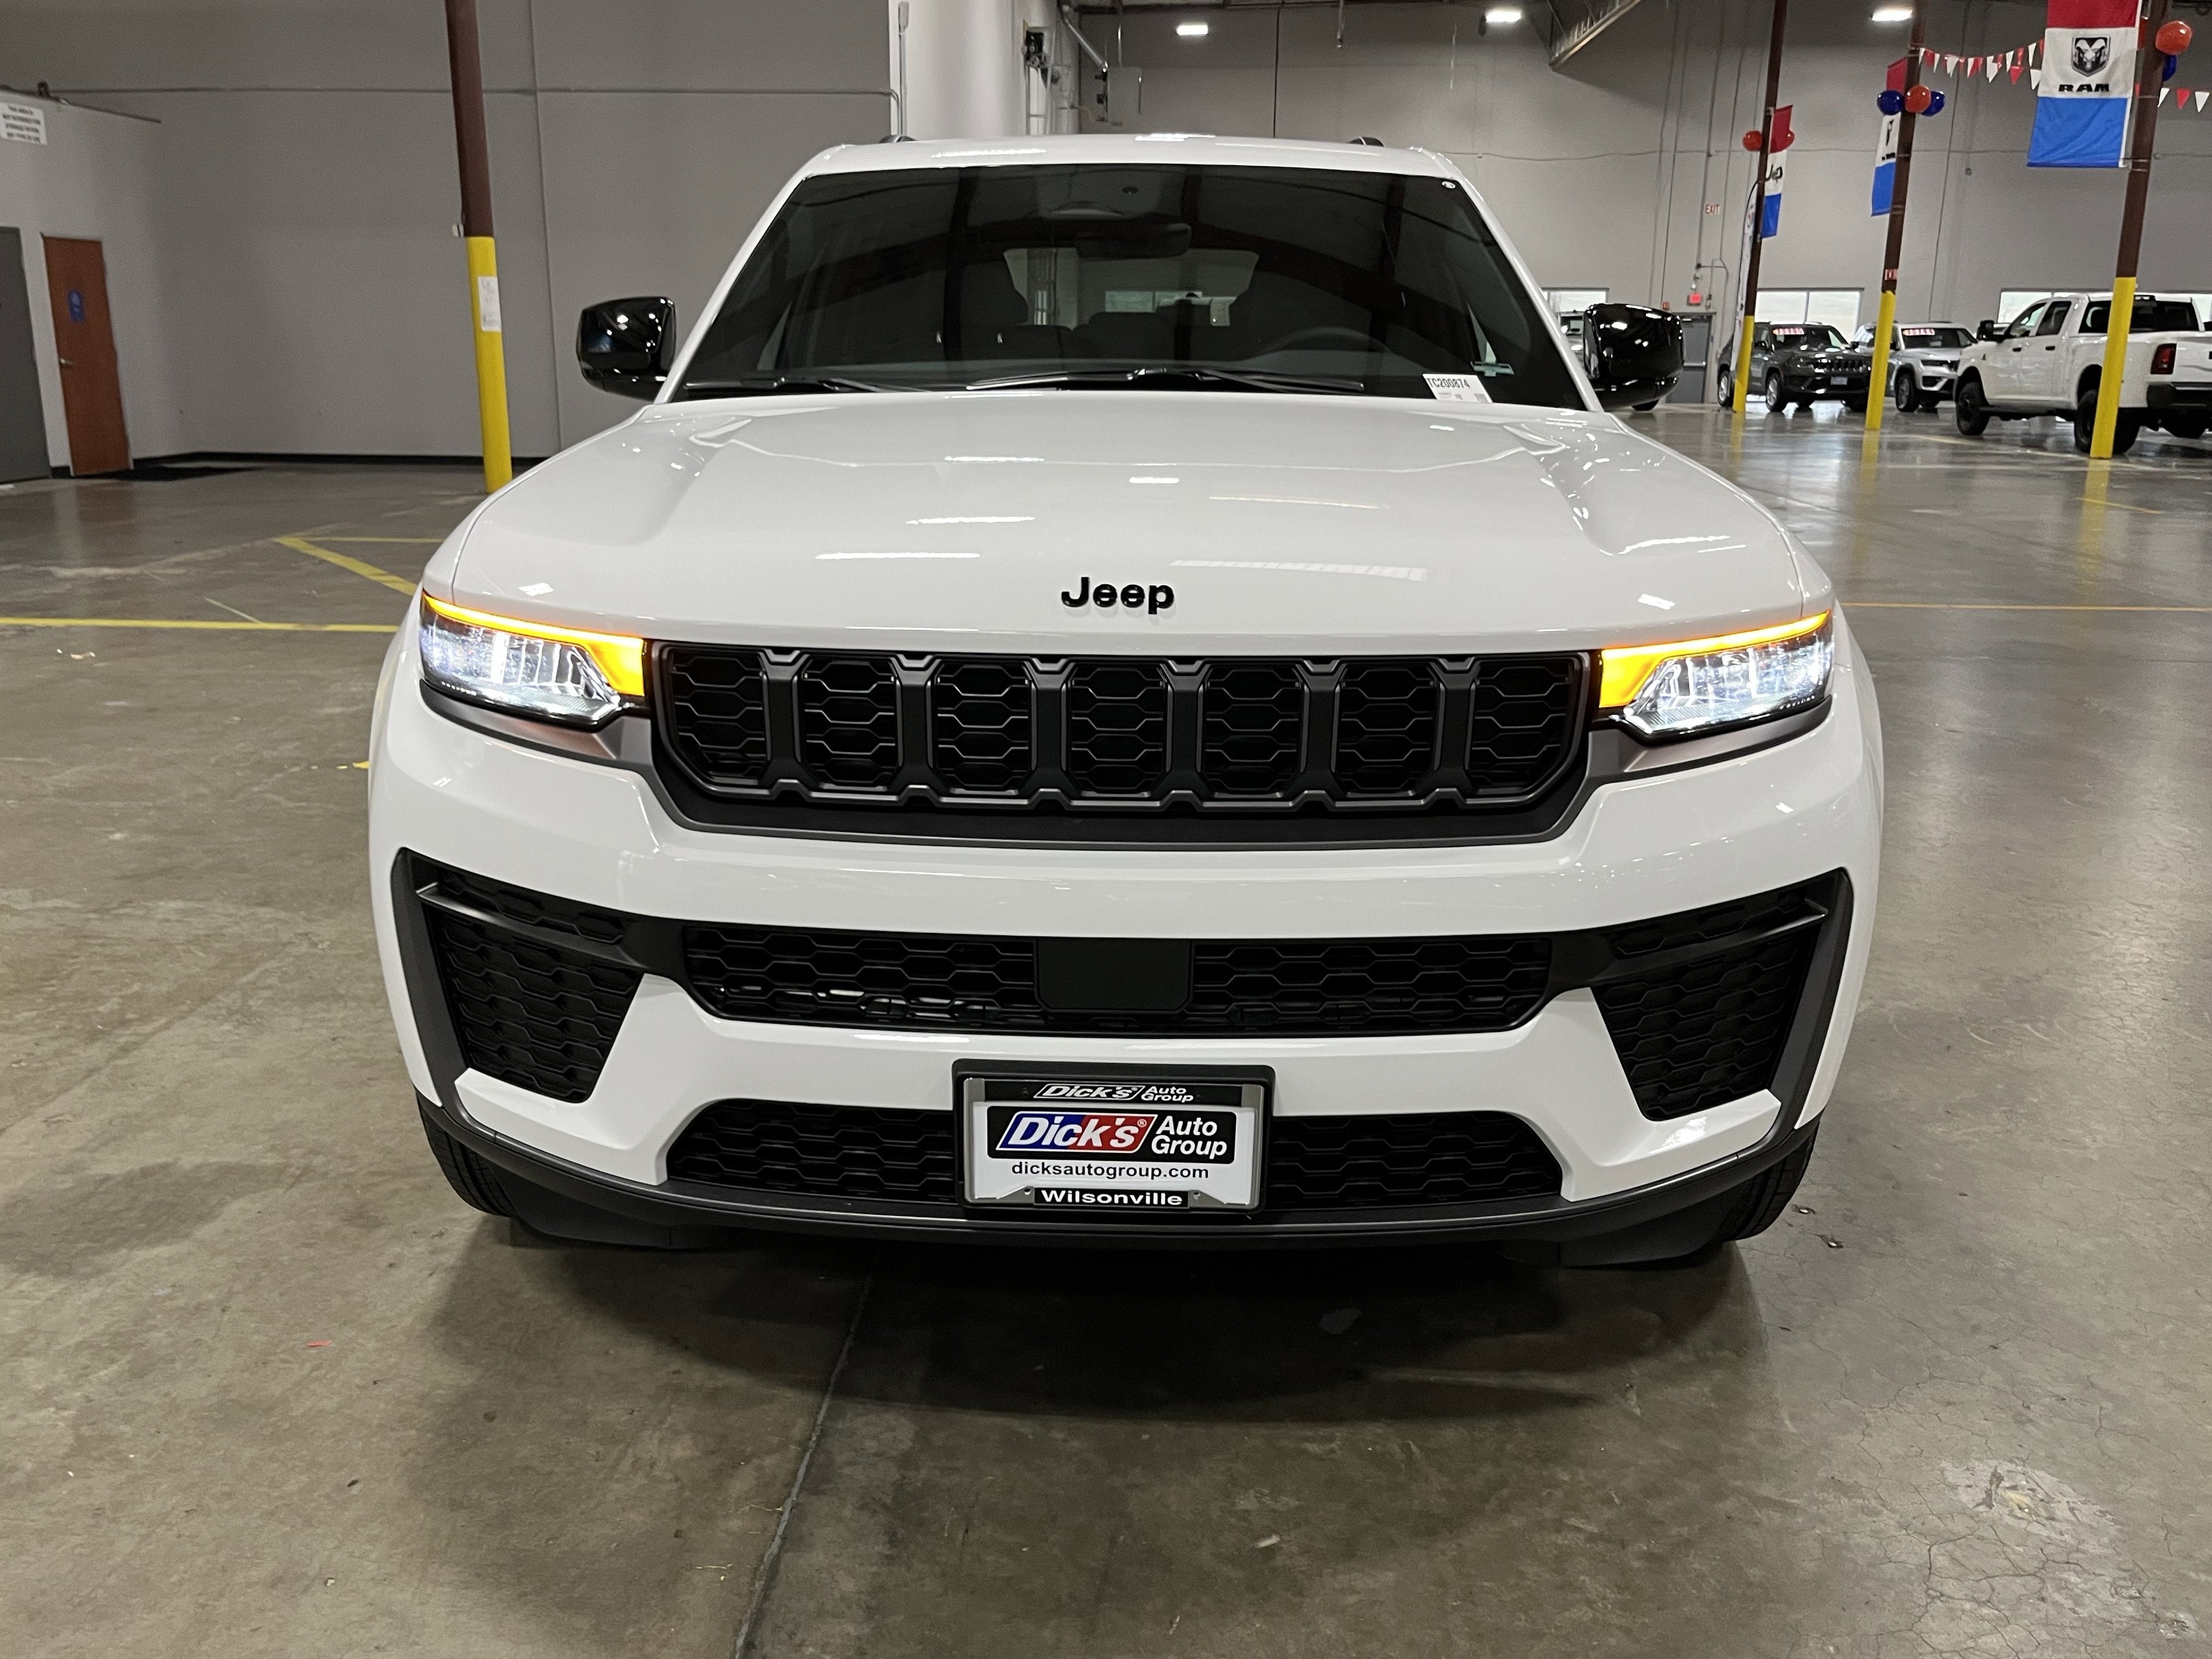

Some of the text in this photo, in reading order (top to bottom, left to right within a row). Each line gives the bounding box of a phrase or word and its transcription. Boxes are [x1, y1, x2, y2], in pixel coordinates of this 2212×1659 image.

[2058, 84, 2109, 92] RAM
[1765, 164, 1783, 183] Jp
[1705, 204, 1720, 214] EXIT
[1426, 378, 1470, 388] TC200874
[1062, 577, 1174, 614] Jeep
[1042, 1085, 1187, 1098] Dick's Auto
[1141, 1093, 1194, 1103] Group
[1156, 1116, 1218, 1136] Auto
[1152, 1135, 1228, 1159] Group
[1012, 1162, 1209, 1180] dicksautogroup.com
[1041, 1189, 1183, 1205] Wilsonville
